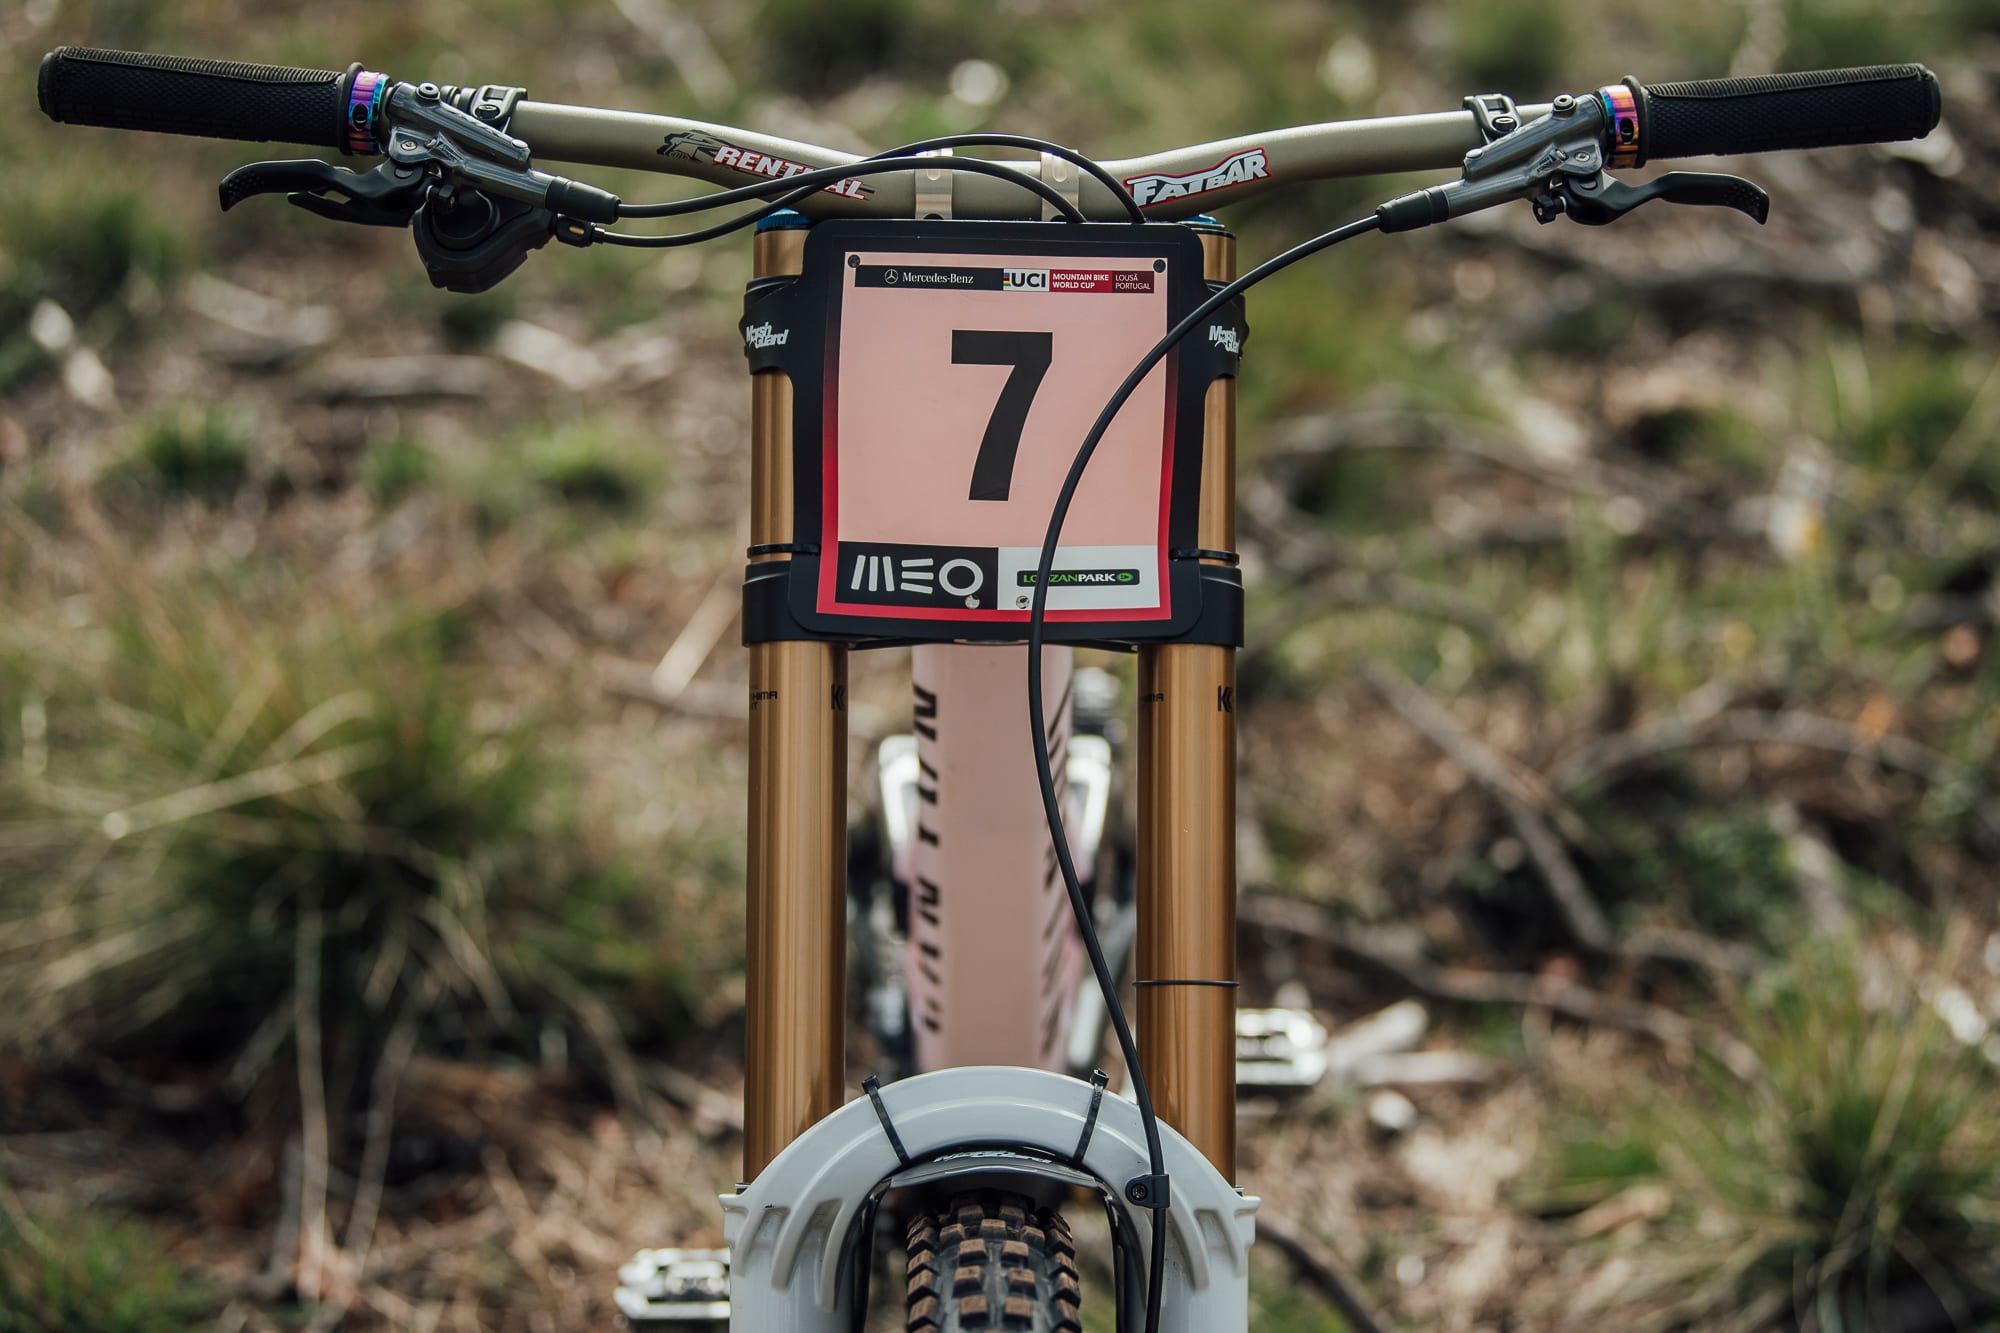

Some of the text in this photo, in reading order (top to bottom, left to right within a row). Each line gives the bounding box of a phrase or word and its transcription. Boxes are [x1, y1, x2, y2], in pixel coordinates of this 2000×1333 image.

[712, 145, 866, 200] RENTAL
[1125, 147, 1270, 207] FATBAR
[902, 272, 974, 284] Mercedes-Benz
[1010, 272, 1046, 288] UCI
[1052, 273, 1093, 281] MOUNTAIN
[1115, 282, 1151, 290] PORTUGAL
[951, 329, 1053, 502] 7
[851, 555, 984, 597] MEO
[1023, 573, 1116, 583] LOZANPARK
